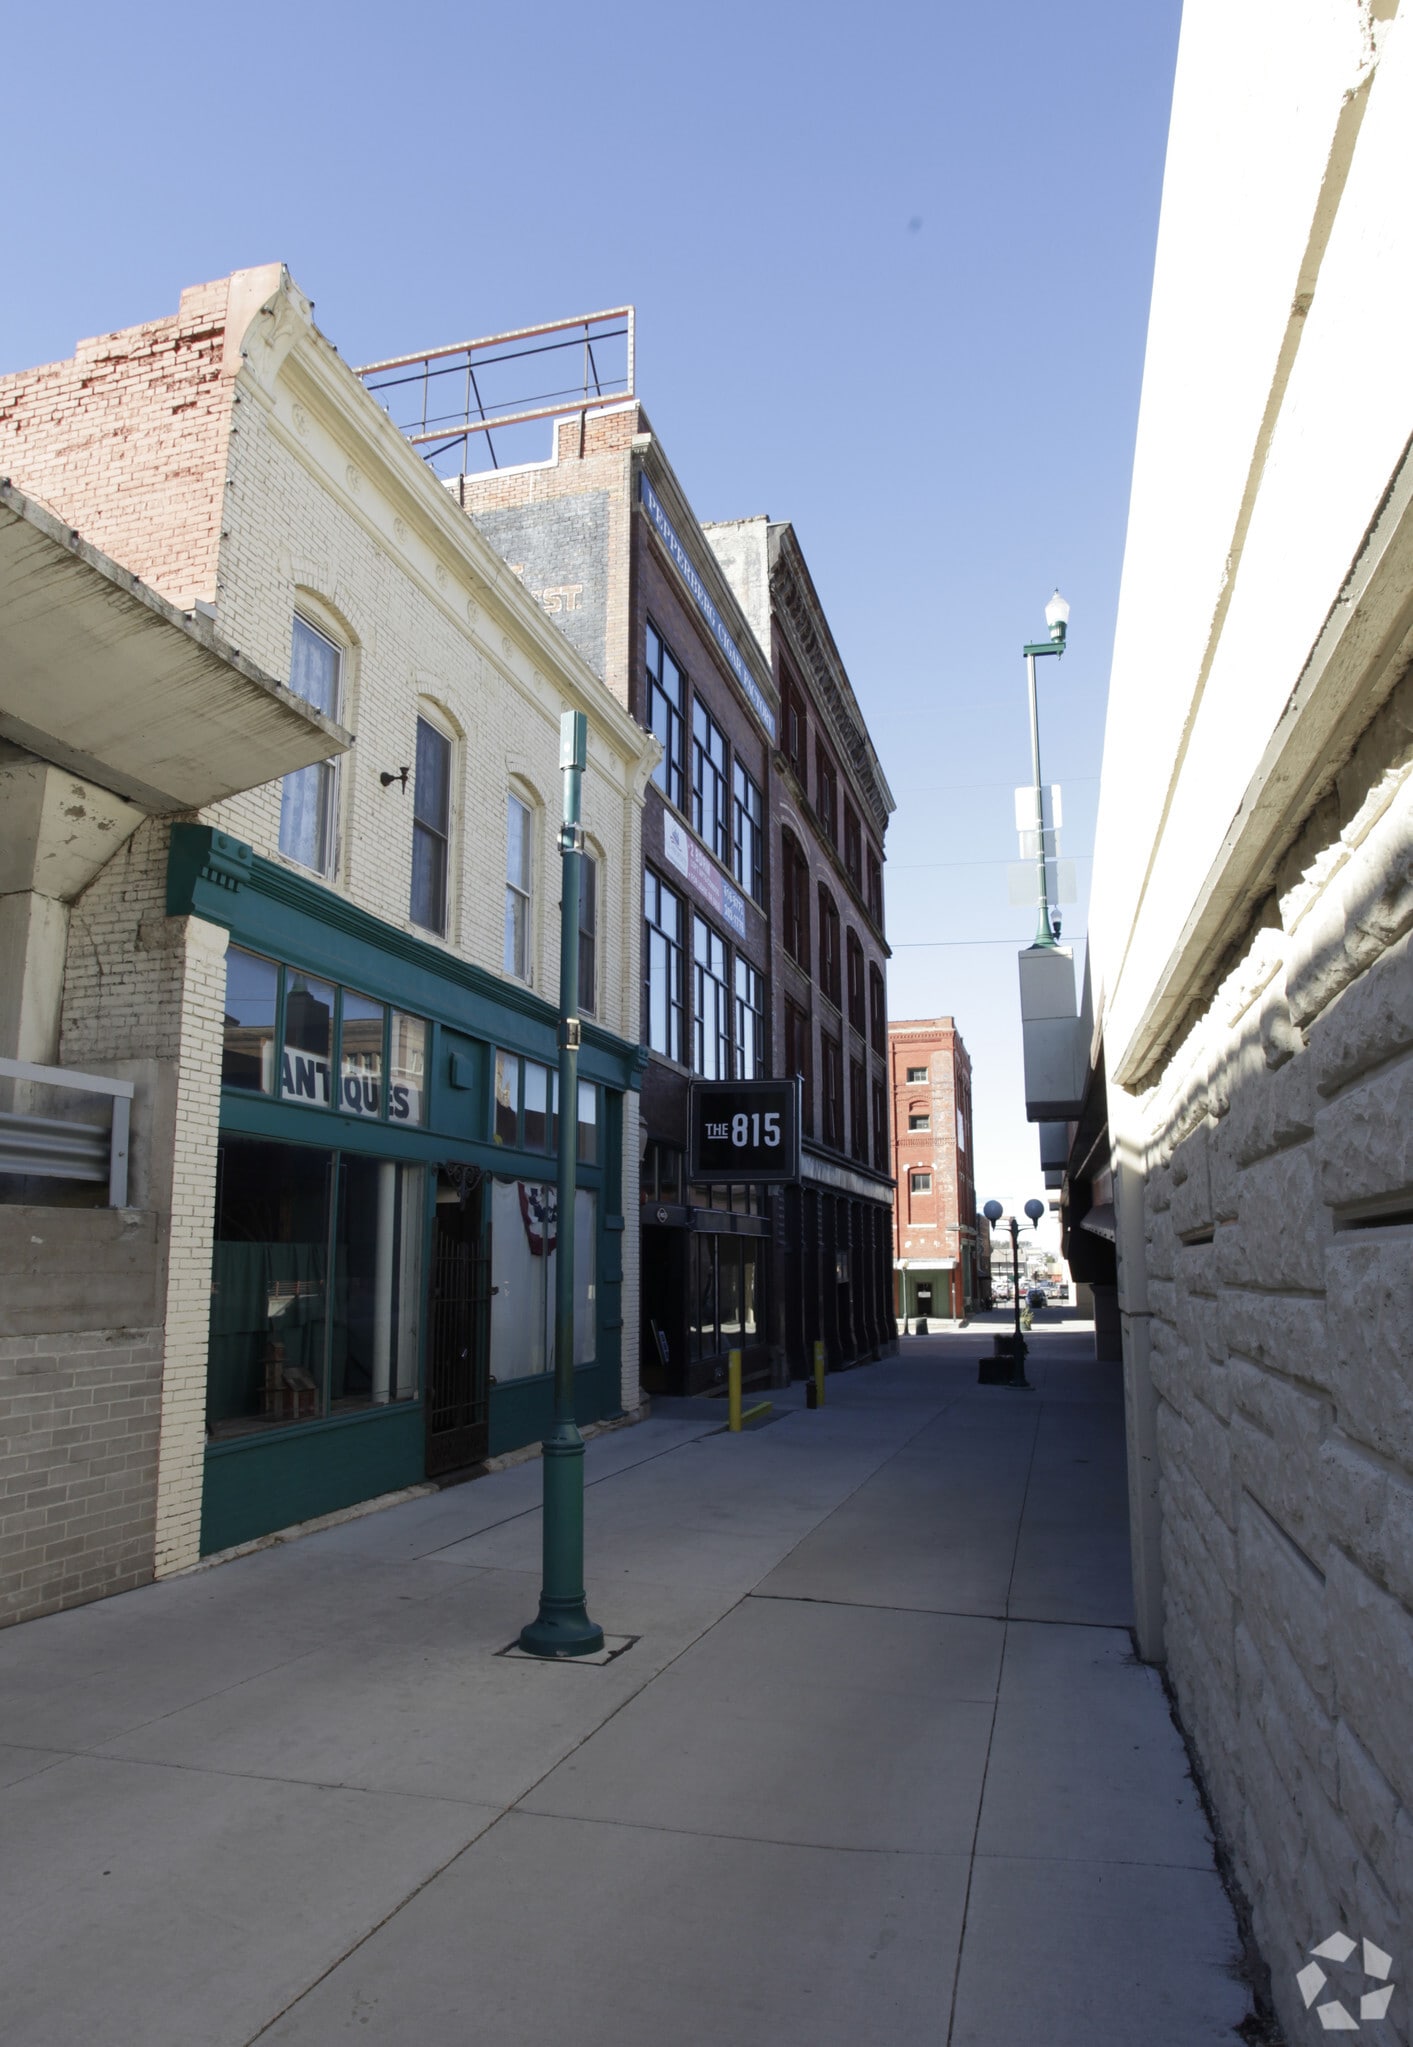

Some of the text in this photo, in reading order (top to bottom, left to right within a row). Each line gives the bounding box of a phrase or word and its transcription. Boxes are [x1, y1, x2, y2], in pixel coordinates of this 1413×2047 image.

[531, 584, 582, 613] ST.
[648, 489, 772, 731] PEPPERBERG CIGAR FACTORY
[705, 1113, 780, 1147] THE 815
